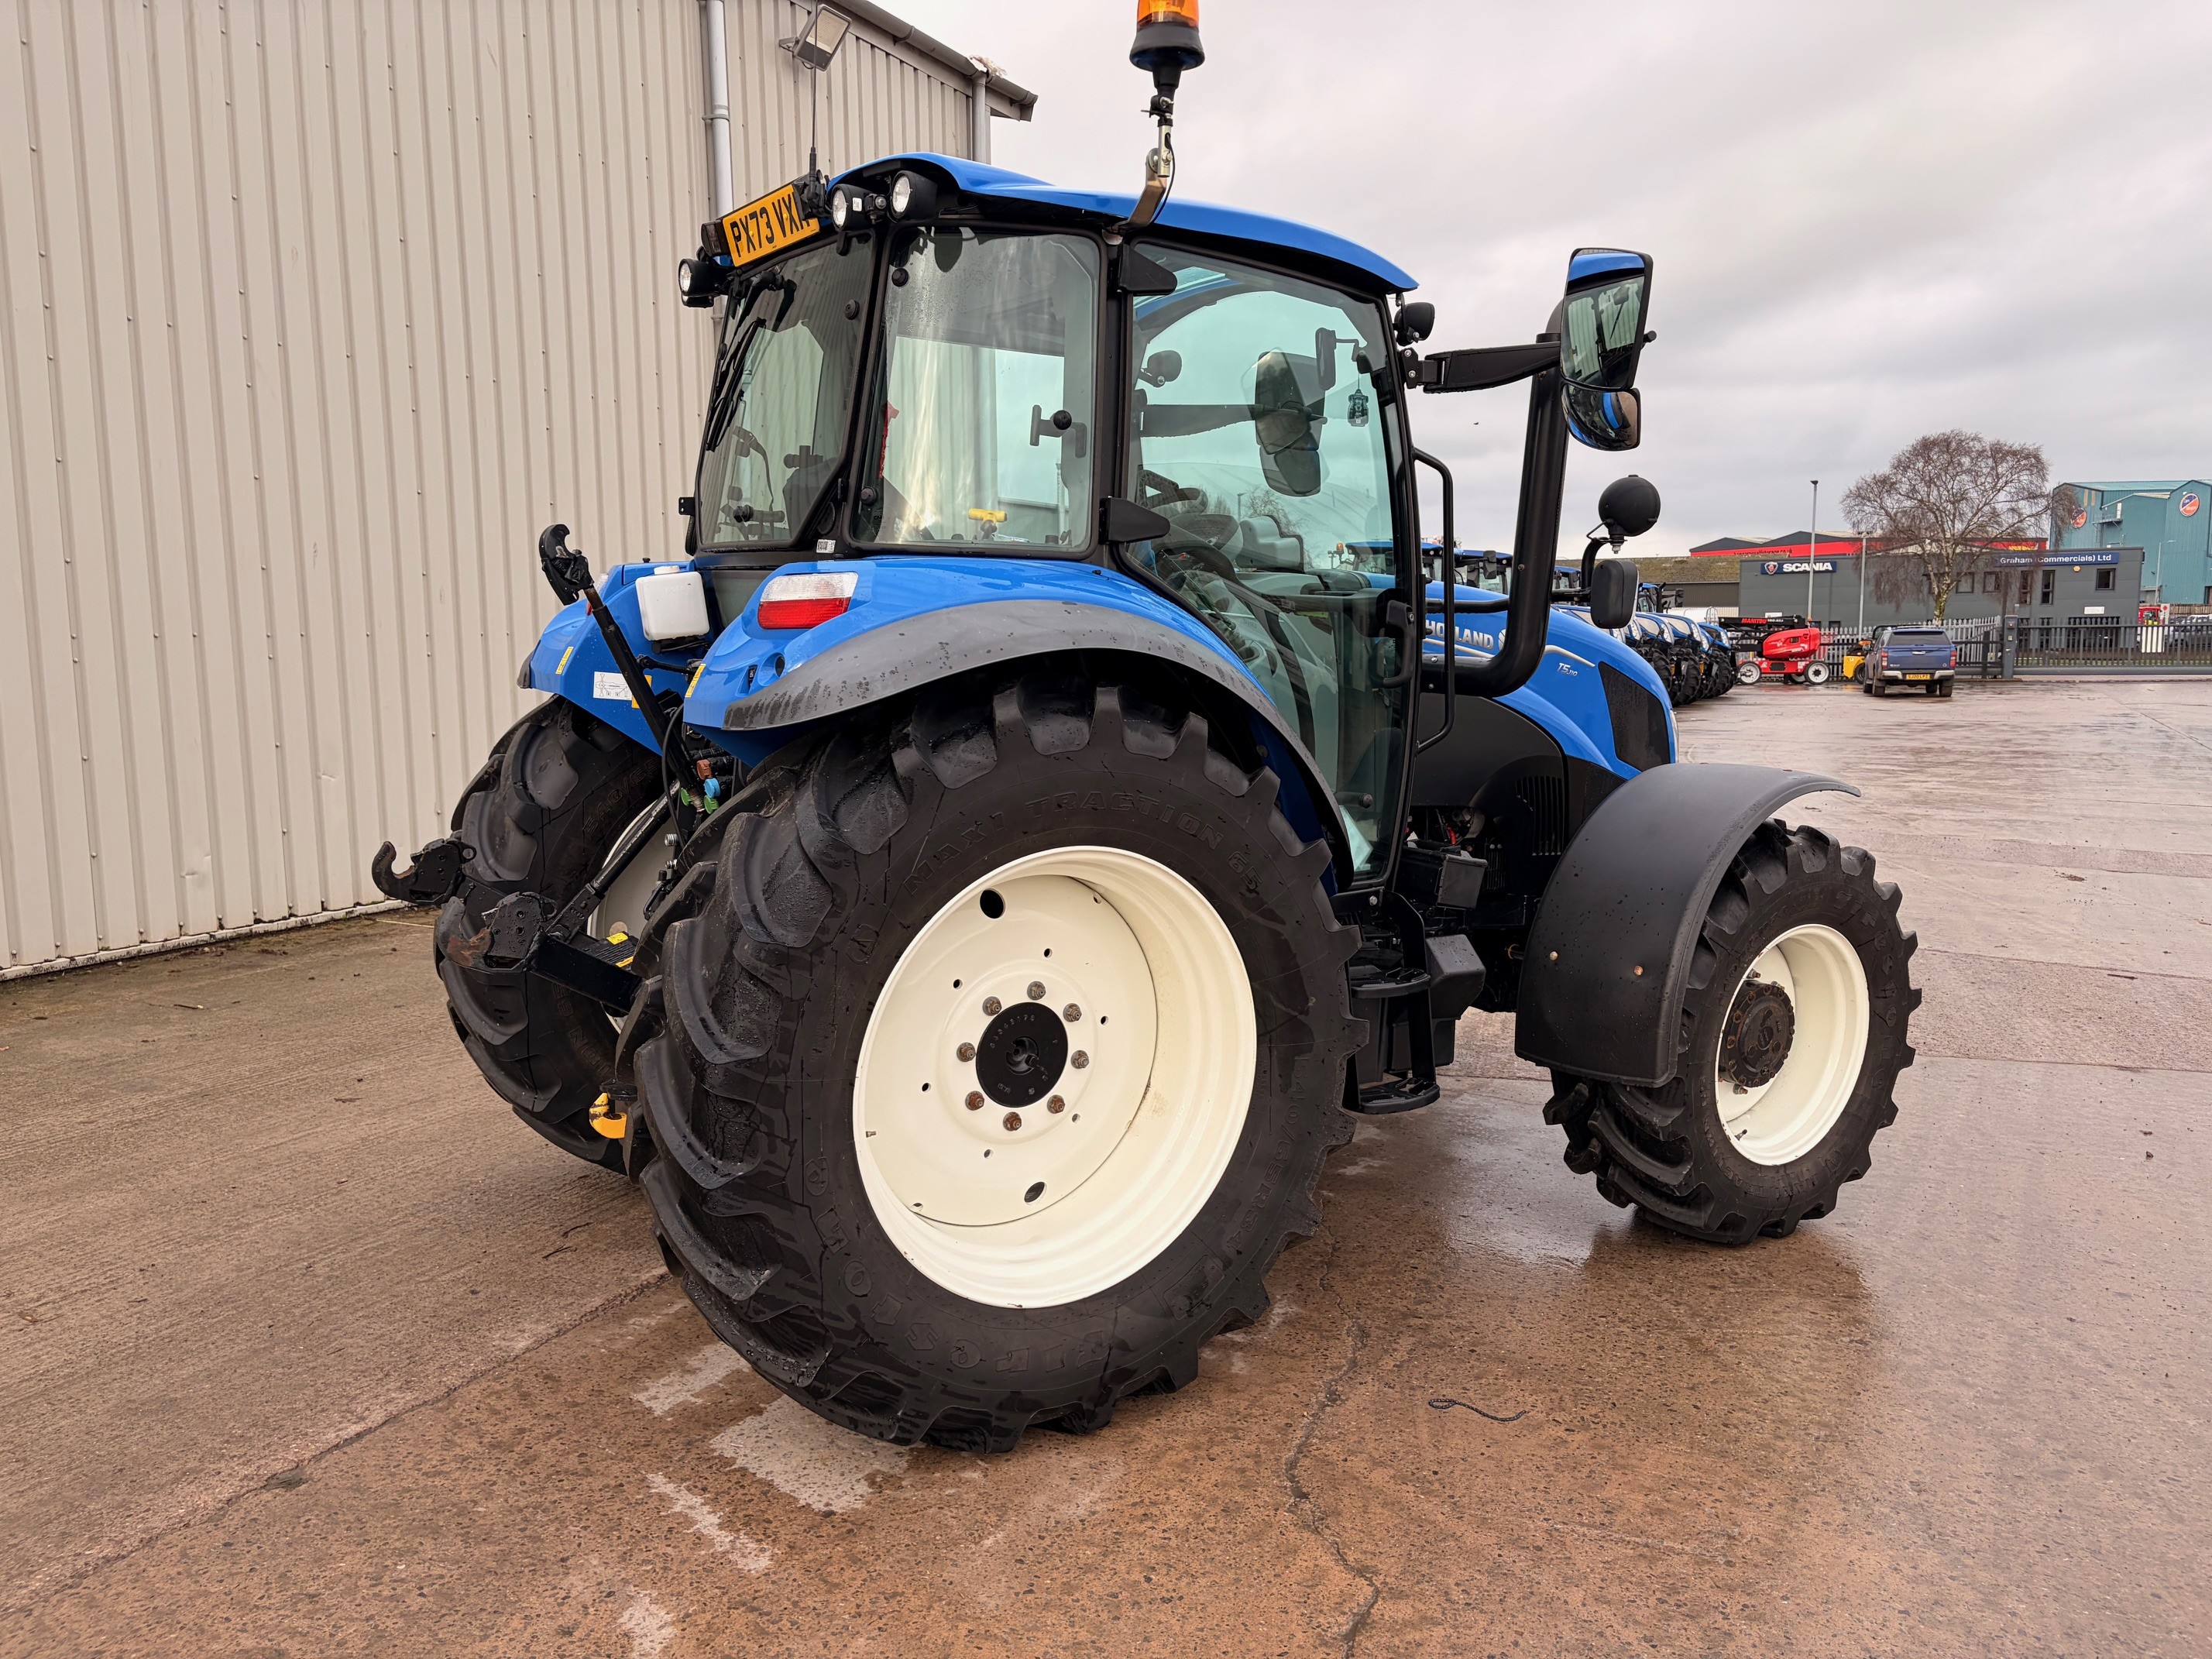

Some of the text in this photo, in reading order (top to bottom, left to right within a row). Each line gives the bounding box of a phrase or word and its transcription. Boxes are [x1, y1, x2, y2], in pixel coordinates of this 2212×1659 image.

[730, 207, 775, 258] PX73
[1783, 562, 1832, 572] SCANIA
[2035, 555, 2096, 564] (Commercials)
[1426, 620, 1494, 650] HOLAND
[1558, 662, 1578, 676] T5.110
[902, 790, 1263, 896] MAXI TRACTION 65
